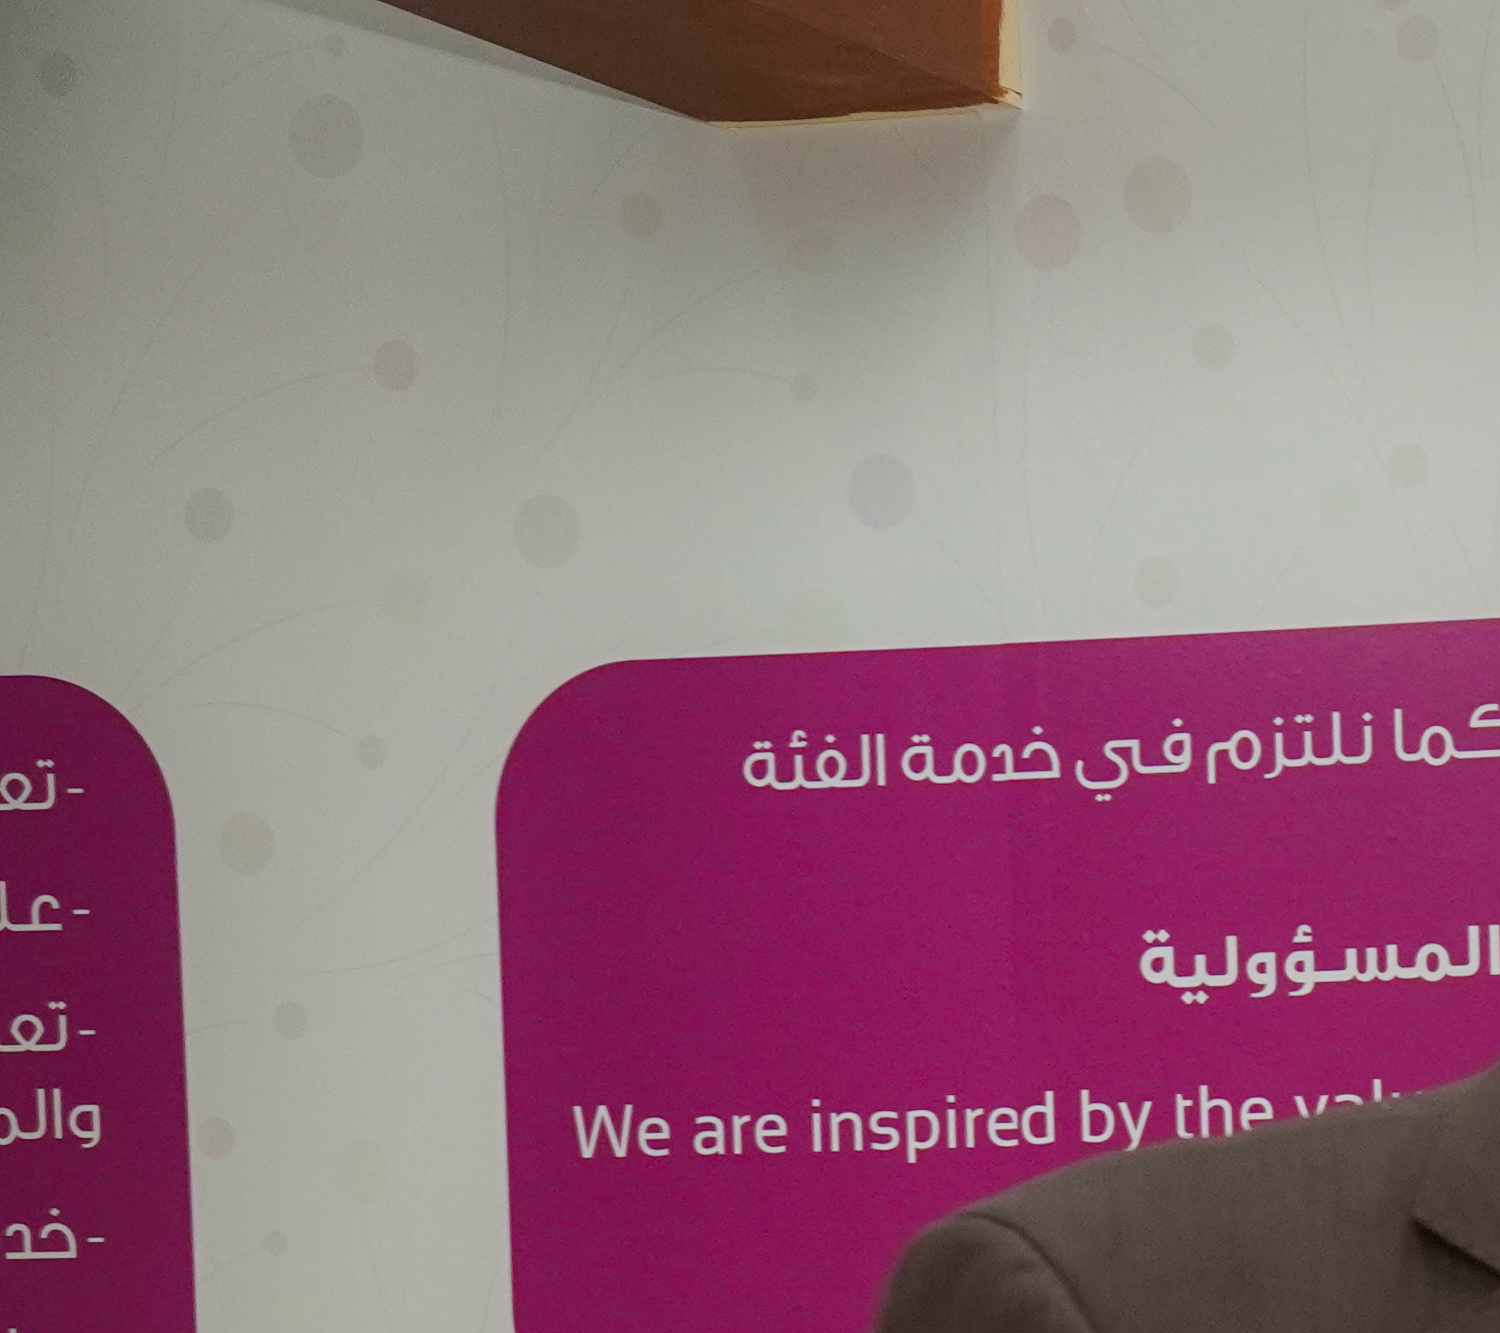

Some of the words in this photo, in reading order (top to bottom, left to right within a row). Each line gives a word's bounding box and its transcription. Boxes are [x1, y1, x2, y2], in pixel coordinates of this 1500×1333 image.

[744, 730, 886, 790] الفئة
[901, 726, 1060, 783] خدمة
[1076, 718, 1192, 801] في
[1207, 712, 1372, 784] نلتزم
[1140, 925, 1500, 1004] المسؤولية
[573, 1105, 670, 1158] We
[694, 1114, 787, 1155] are
[812, 1091, 1055, 1163] inspired
[1081, 1090, 1152, 1151] by
[1175, 1084, 1275, 1139] the
